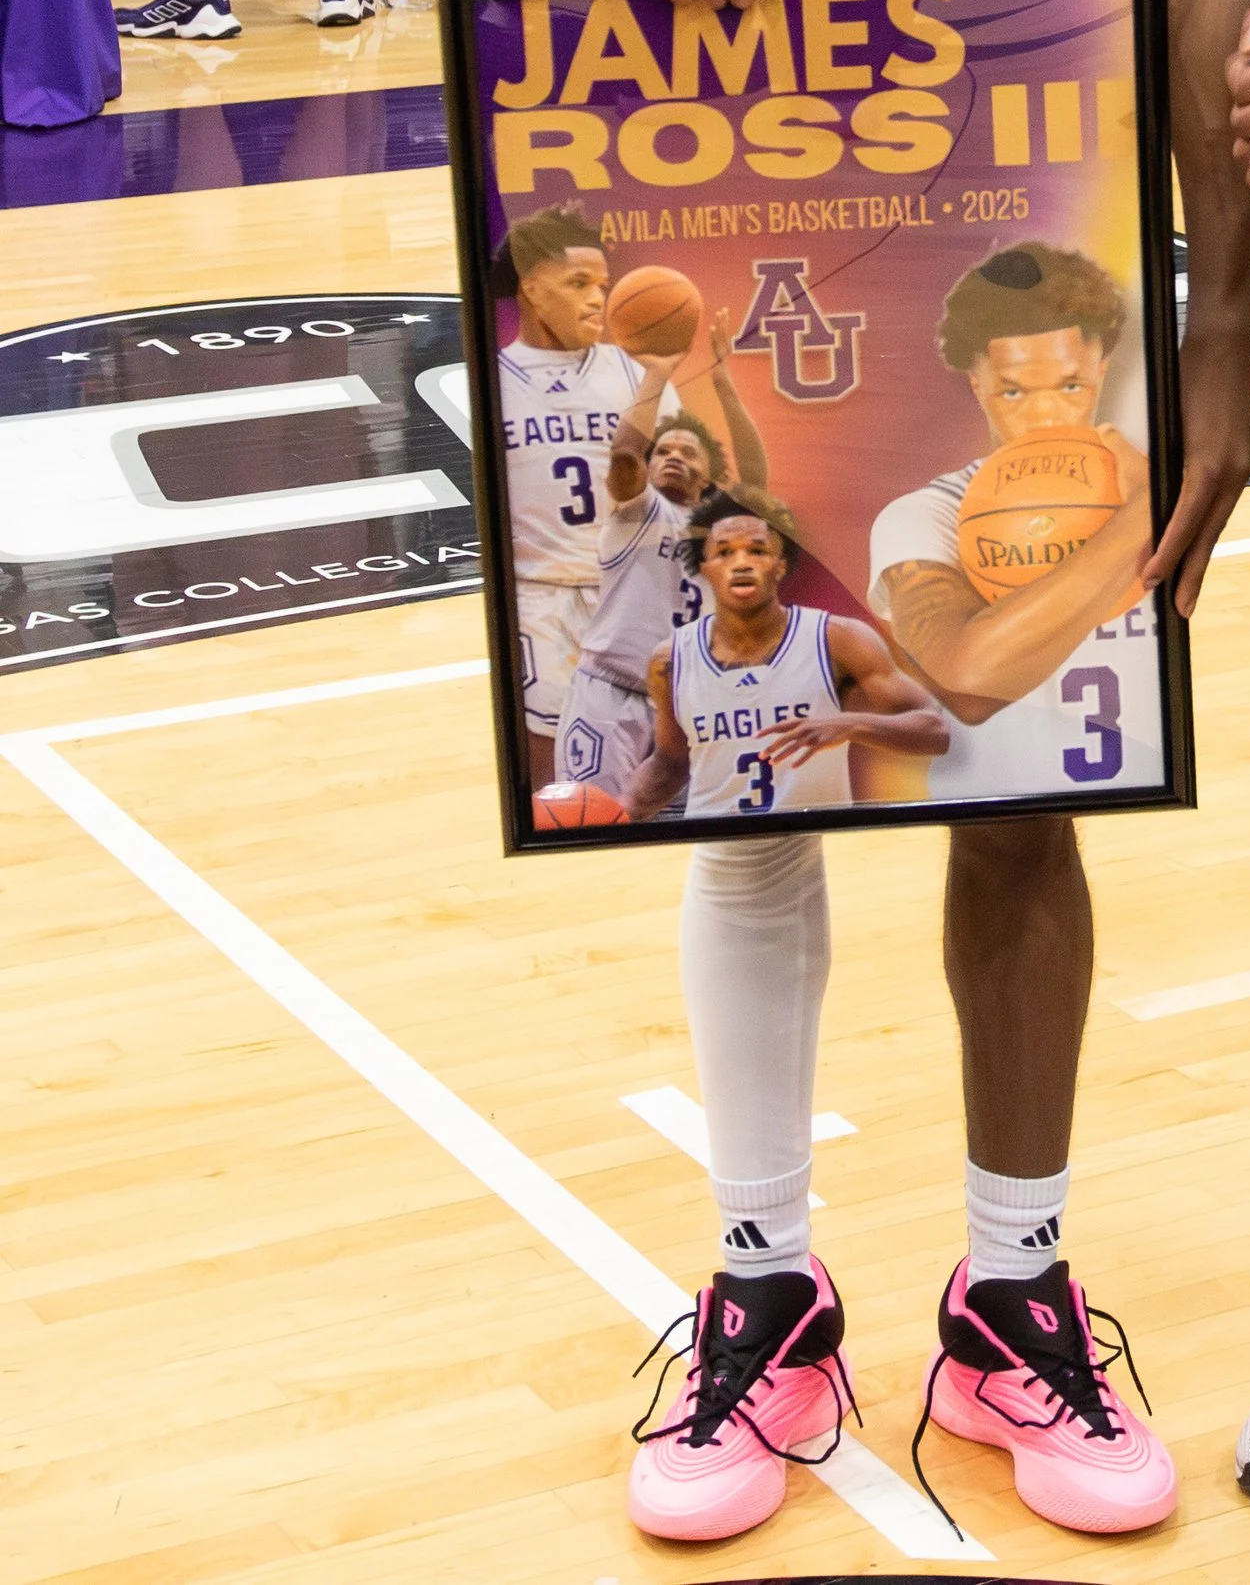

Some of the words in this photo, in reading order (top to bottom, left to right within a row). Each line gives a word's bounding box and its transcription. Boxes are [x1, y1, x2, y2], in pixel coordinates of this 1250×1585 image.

[492, 89, 955, 194] ROSS
[600, 210, 675, 243] AVILA
[682, 204, 762, 238] MEN'S
[767, 194, 934, 234] BASKETBALL
[961, 187, 1030, 223] 2025
[137, 320, 356, 356] 1890
[731, 257, 866, 404] AU
[552, 455, 597, 526] 3
[133, 541, 484, 608] COLLEGIA
[672, 577, 703, 628] 3
[1060, 665, 1124, 784] 3
[736, 752, 775, 813] 3
